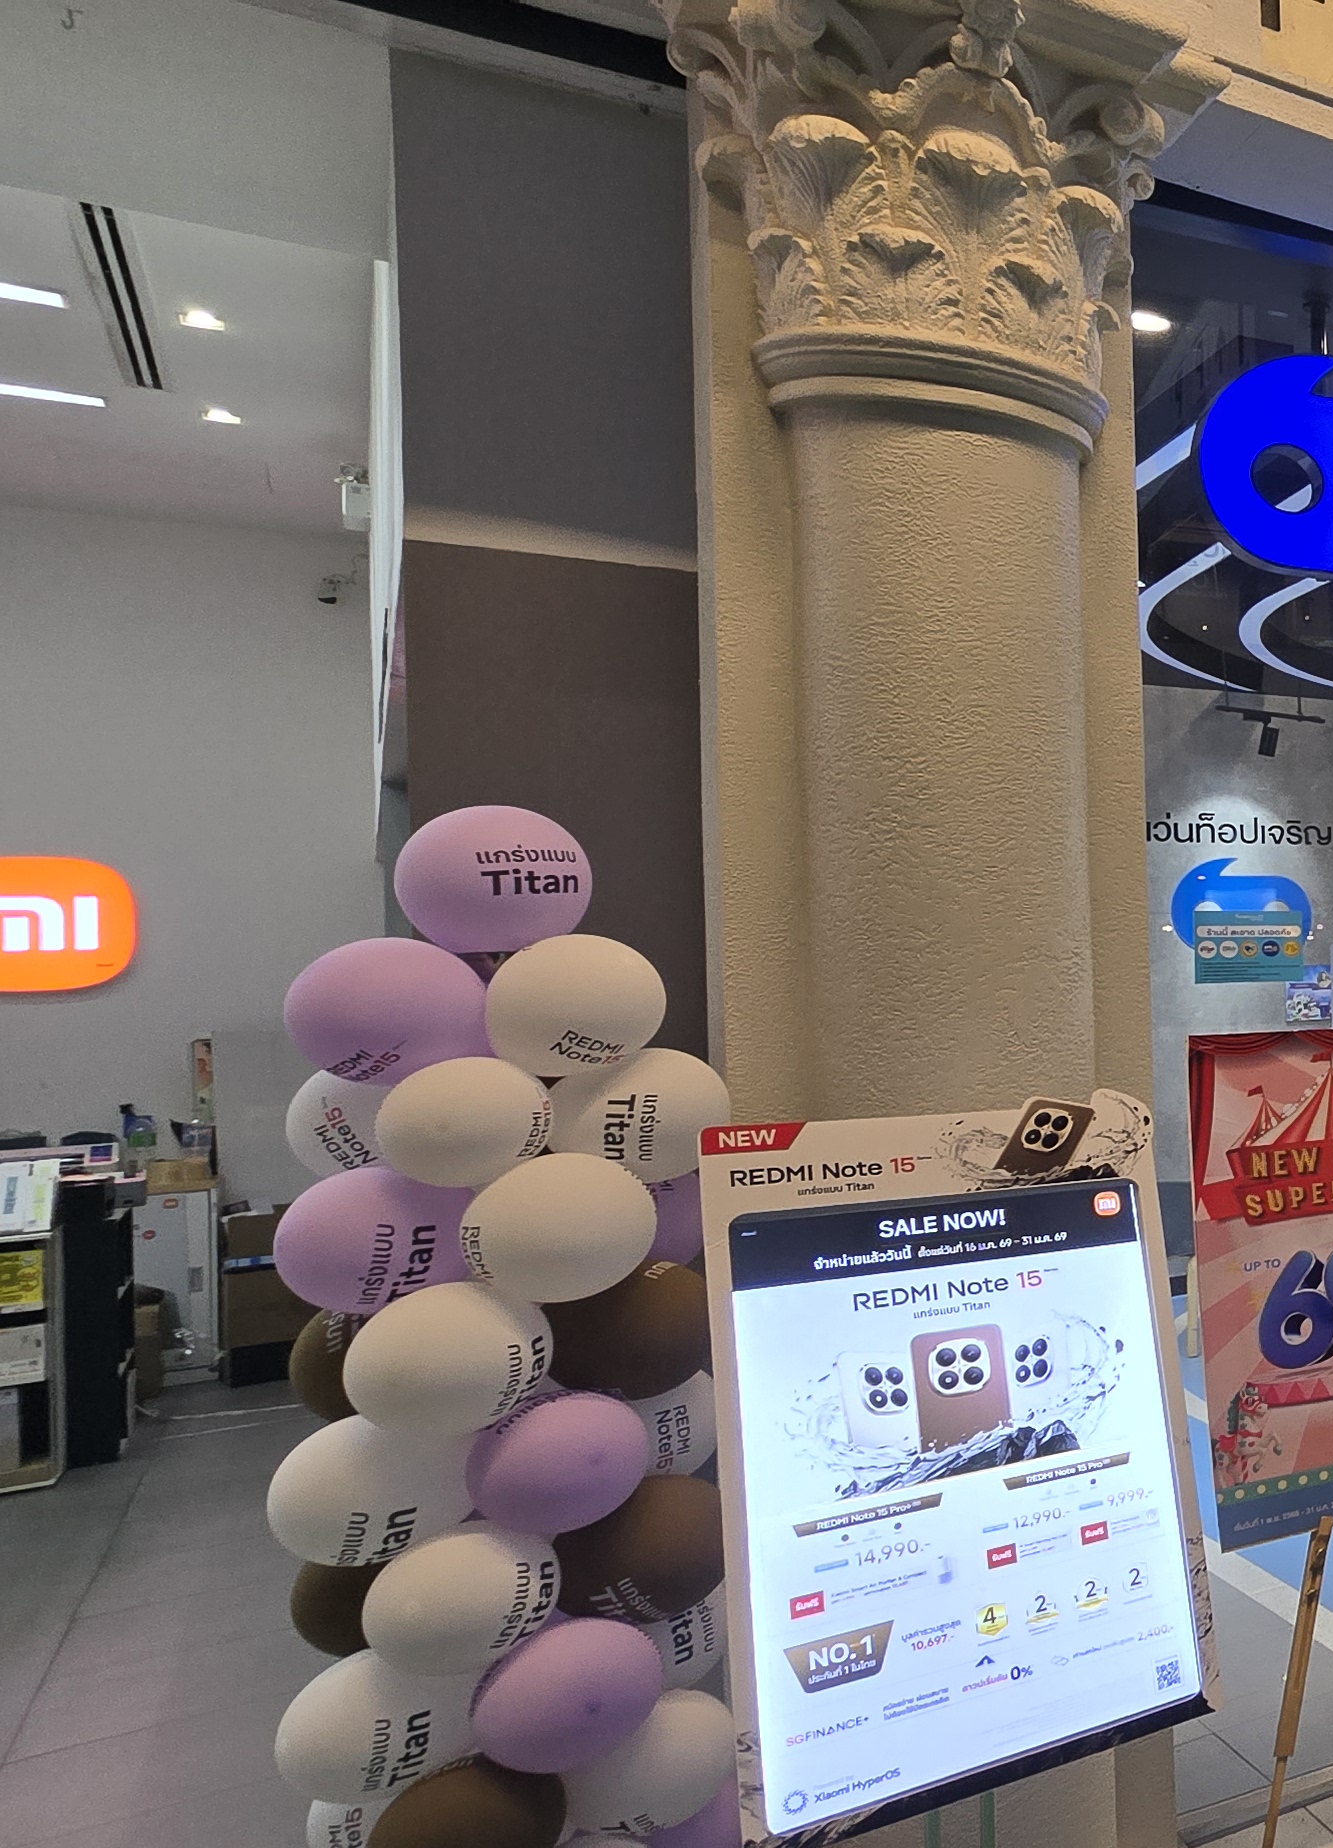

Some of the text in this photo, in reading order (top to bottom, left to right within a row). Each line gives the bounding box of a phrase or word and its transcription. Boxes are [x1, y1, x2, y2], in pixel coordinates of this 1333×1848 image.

[475, 844, 577, 864] แกร่งแบบ
[480, 868, 579, 896] Titan
[560, 1030, 625, 1054] REDMI
[602, 1093, 637, 1161] Titan
[717, 1129, 777, 1149] NEW
[729, 1157, 916, 1188] REDMI Note 15
[1251, 1146, 1318, 1178] NEW
[797, 1181, 875, 1196] แกร่งแบบ Titan
[878, 1208, 1007, 1239] SALE NOW!
[357, 1222, 396, 1305] แกร่งแบบ
[813, 1243, 912, 1270] จำหน่ายแล้ววันนี้
[965, 1242, 976, 1252] 16
[999, 1238, 1013, 1248] 69
[1021, 1235, 1033, 1245] 31
[1054, 1231, 1067, 1242] 69
[1243, 1258, 1281, 1272] UP TO
[853, 1270, 1043, 1312] REDMI Note 15
[913, 1300, 991, 1319] แกร่งแบบ Titan
[672, 1404, 691, 1455] REDMI
[1026, 1473, 1053, 1484] REDMI
[1055, 1468, 1076, 1478] Note
[1088, 1461, 1103, 1470] Pro
[816, 1517, 849, 1531] REDMI
[851, 1511, 875, 1524] Note
[877, 1508, 888, 1517] 15
[1013, 1507, 1070, 1529] 12,990.-
[855, 1538, 931, 1567] 14,990.-
[1084, 1580, 1097, 1598] 2
[1128, 1568, 1143, 1586] 2
[490, 1562, 531, 1649] แกร่งแบบ
[511, 1560, 554, 1644] Titan
[983, 1607, 997, 1624] 4
[1034, 1595, 1048, 1613] 2
[668, 1610, 694, 1665] itan
[843, 1665, 850, 1675] 1
[1010, 1664, 1033, 1681] 0%
[361, 1718, 391, 1792] แกร่งแบบ
[388, 1709, 431, 1787] Titan
[814, 1767, 901, 1804] Xiaomi HyperOS
